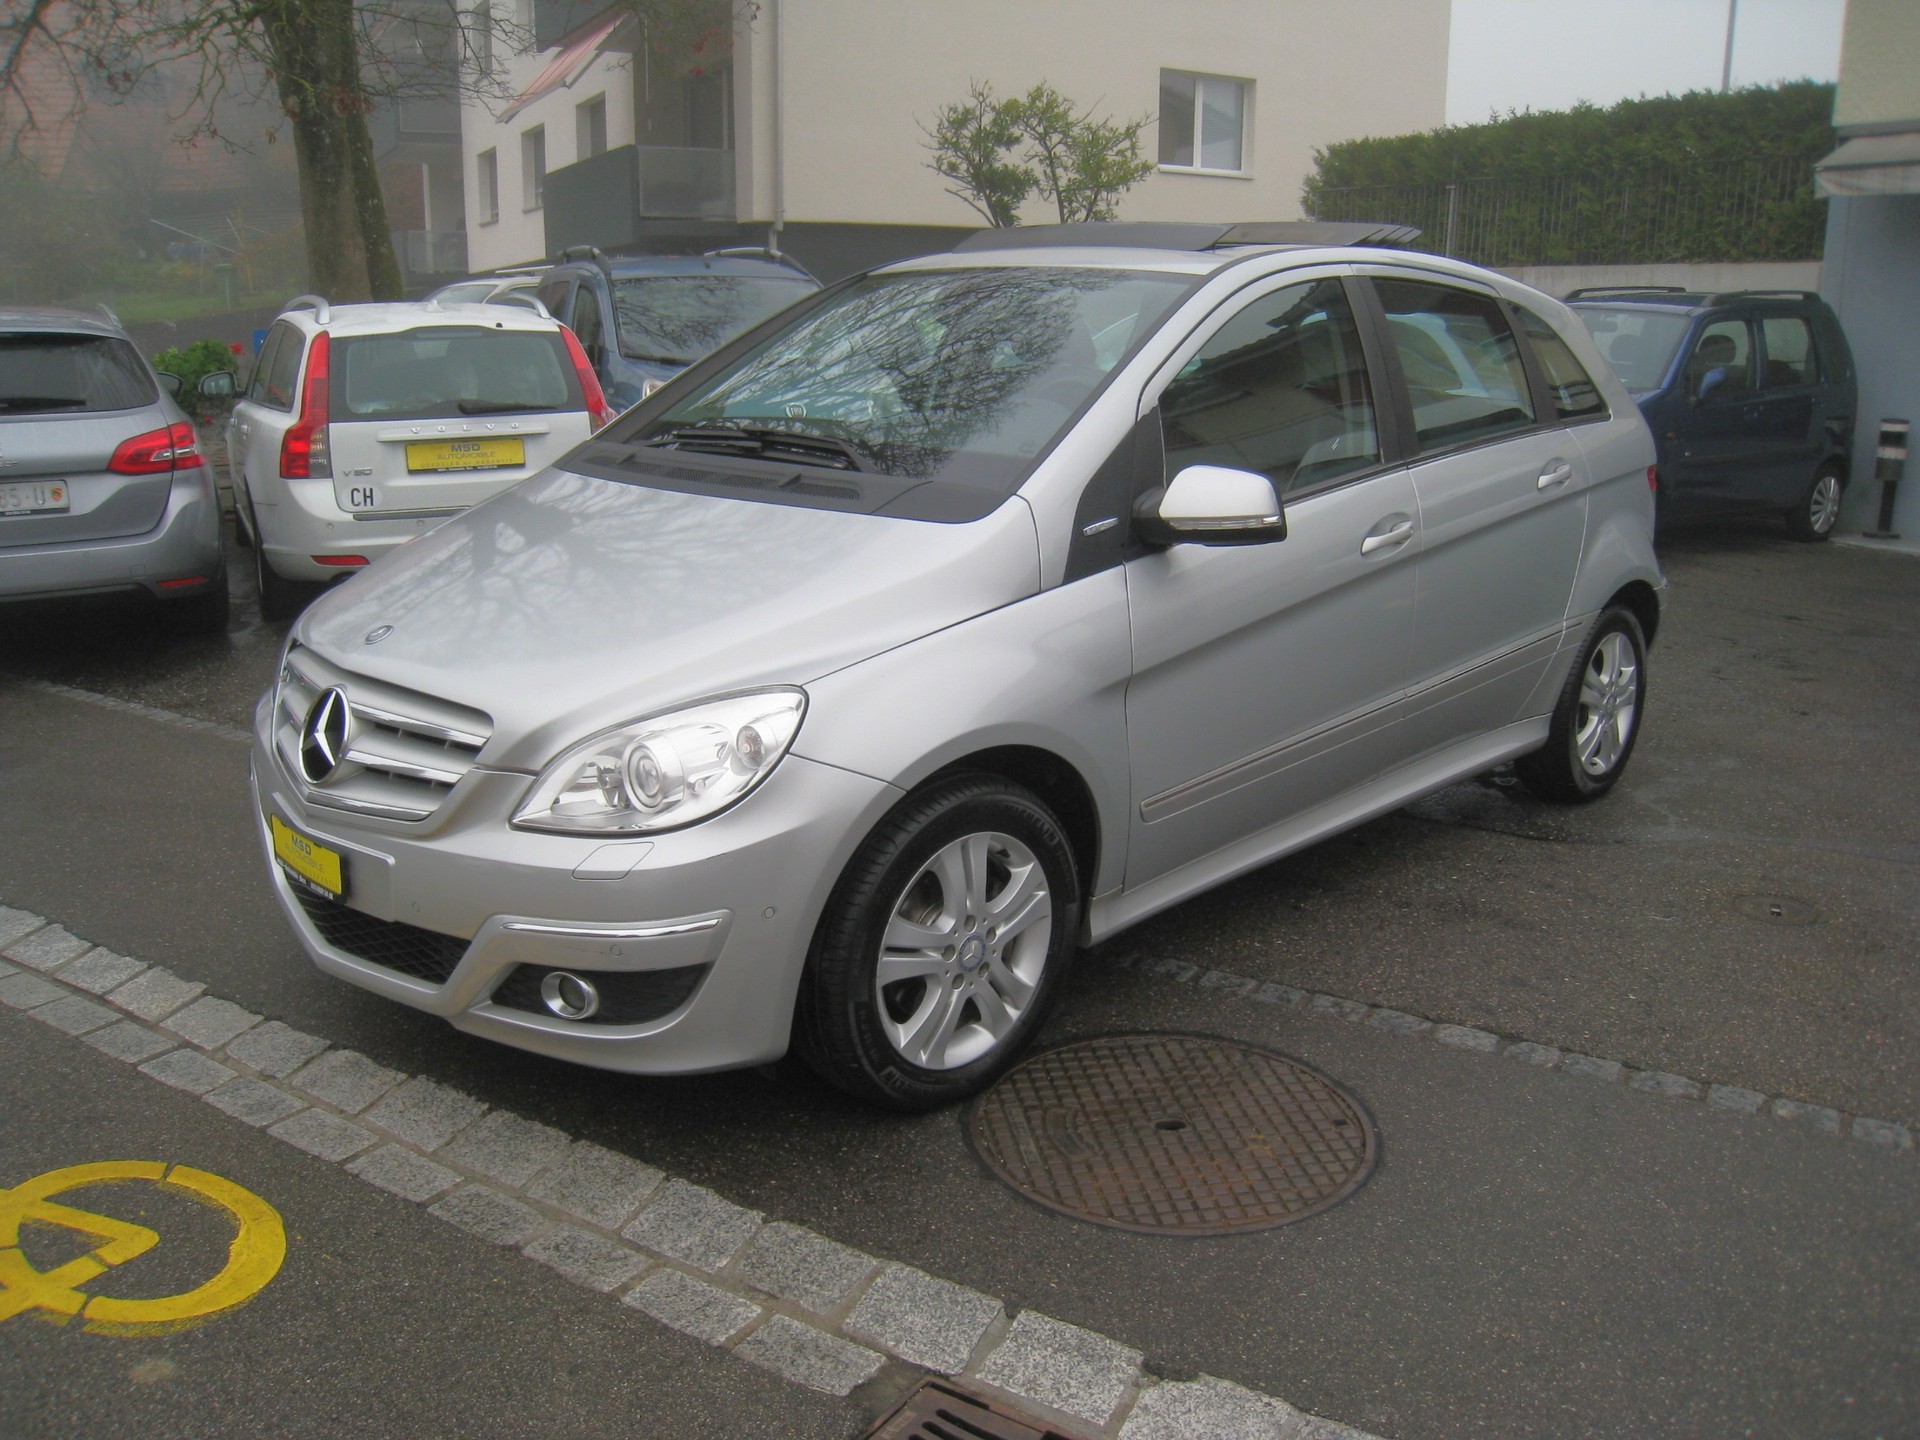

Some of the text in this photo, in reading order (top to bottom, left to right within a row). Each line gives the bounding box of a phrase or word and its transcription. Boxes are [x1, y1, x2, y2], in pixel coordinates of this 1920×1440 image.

[411, 422, 519, 434] VOLVO
[451, 443, 481, 453] MSD
[437, 451, 496, 460] AUTOMOBILE
[351, 487, 374, 507] CH
[291, 834, 312, 856] MSD
